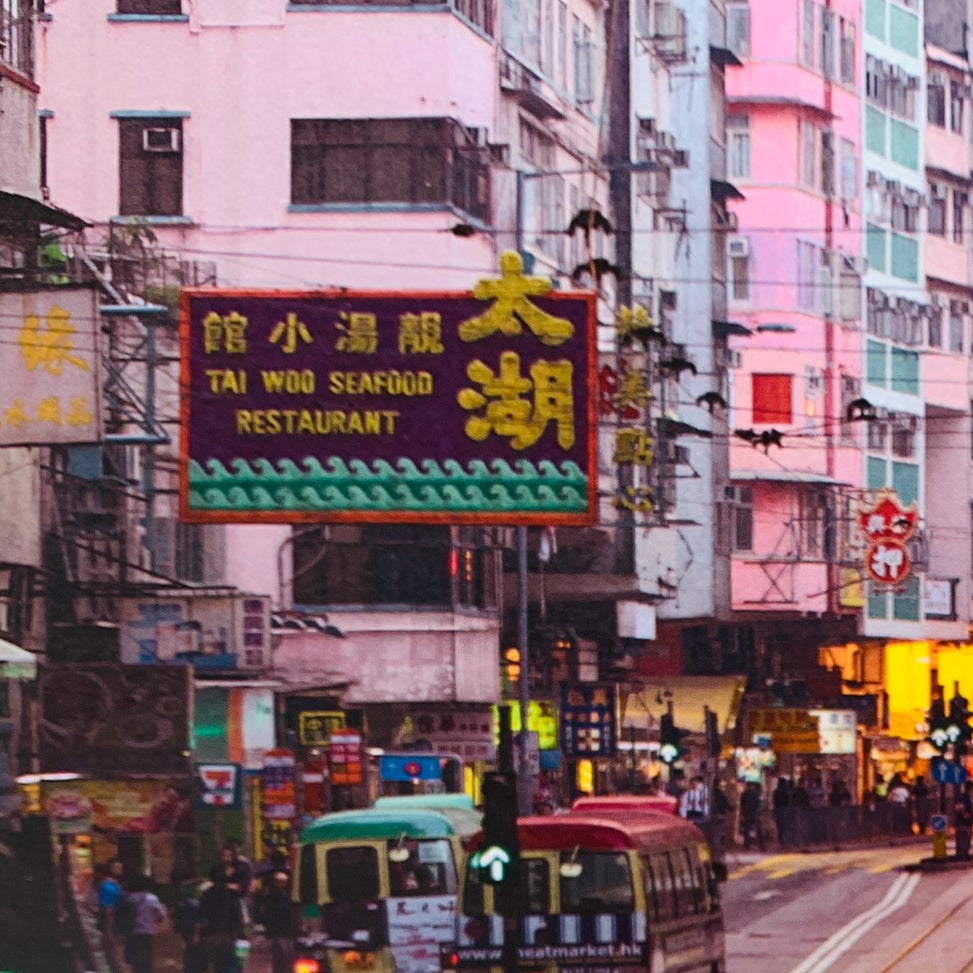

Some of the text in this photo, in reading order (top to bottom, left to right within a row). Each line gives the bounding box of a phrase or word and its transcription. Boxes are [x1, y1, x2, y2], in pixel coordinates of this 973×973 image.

[457, 250, 575, 450] 太湖
[206, 369, 433, 396] TAI WOO SEAFOOD
[236, 409, 400, 435] RESTAURANT
[871, 545, 903, 578] 押
